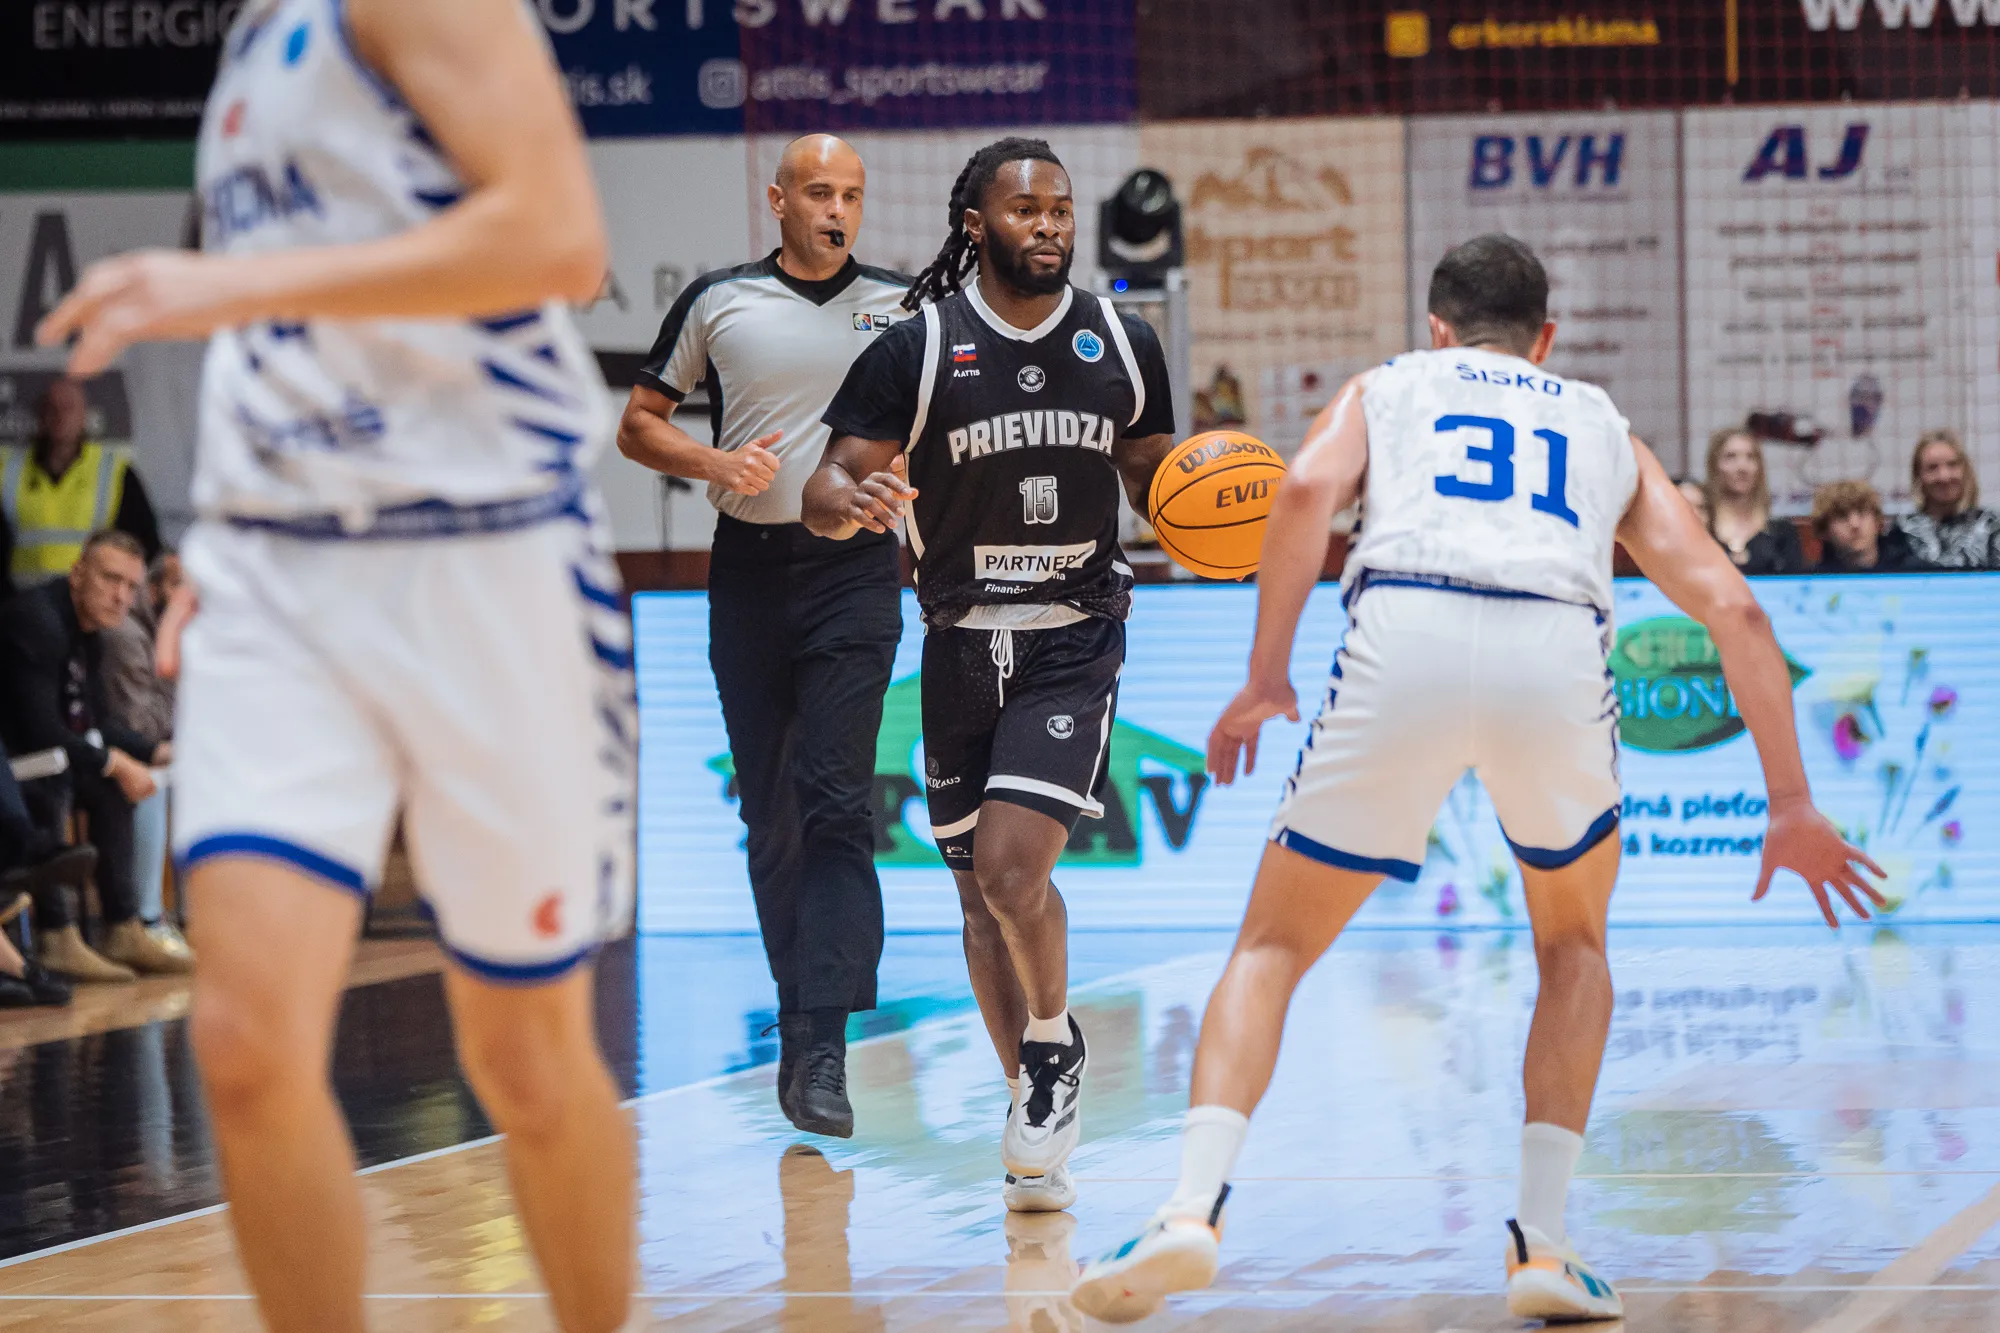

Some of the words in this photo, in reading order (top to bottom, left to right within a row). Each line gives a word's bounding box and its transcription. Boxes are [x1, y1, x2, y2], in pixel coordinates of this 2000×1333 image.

[1468, 130, 1626, 189] BVH
[947, 409, 1115, 466] PRIEVIDZA
[1176, 439, 1273, 474] Wilson
[1216, 480, 1268, 509] EVO
[1434, 414, 1579, 530] 31
[1019, 475, 1059, 525] 15
